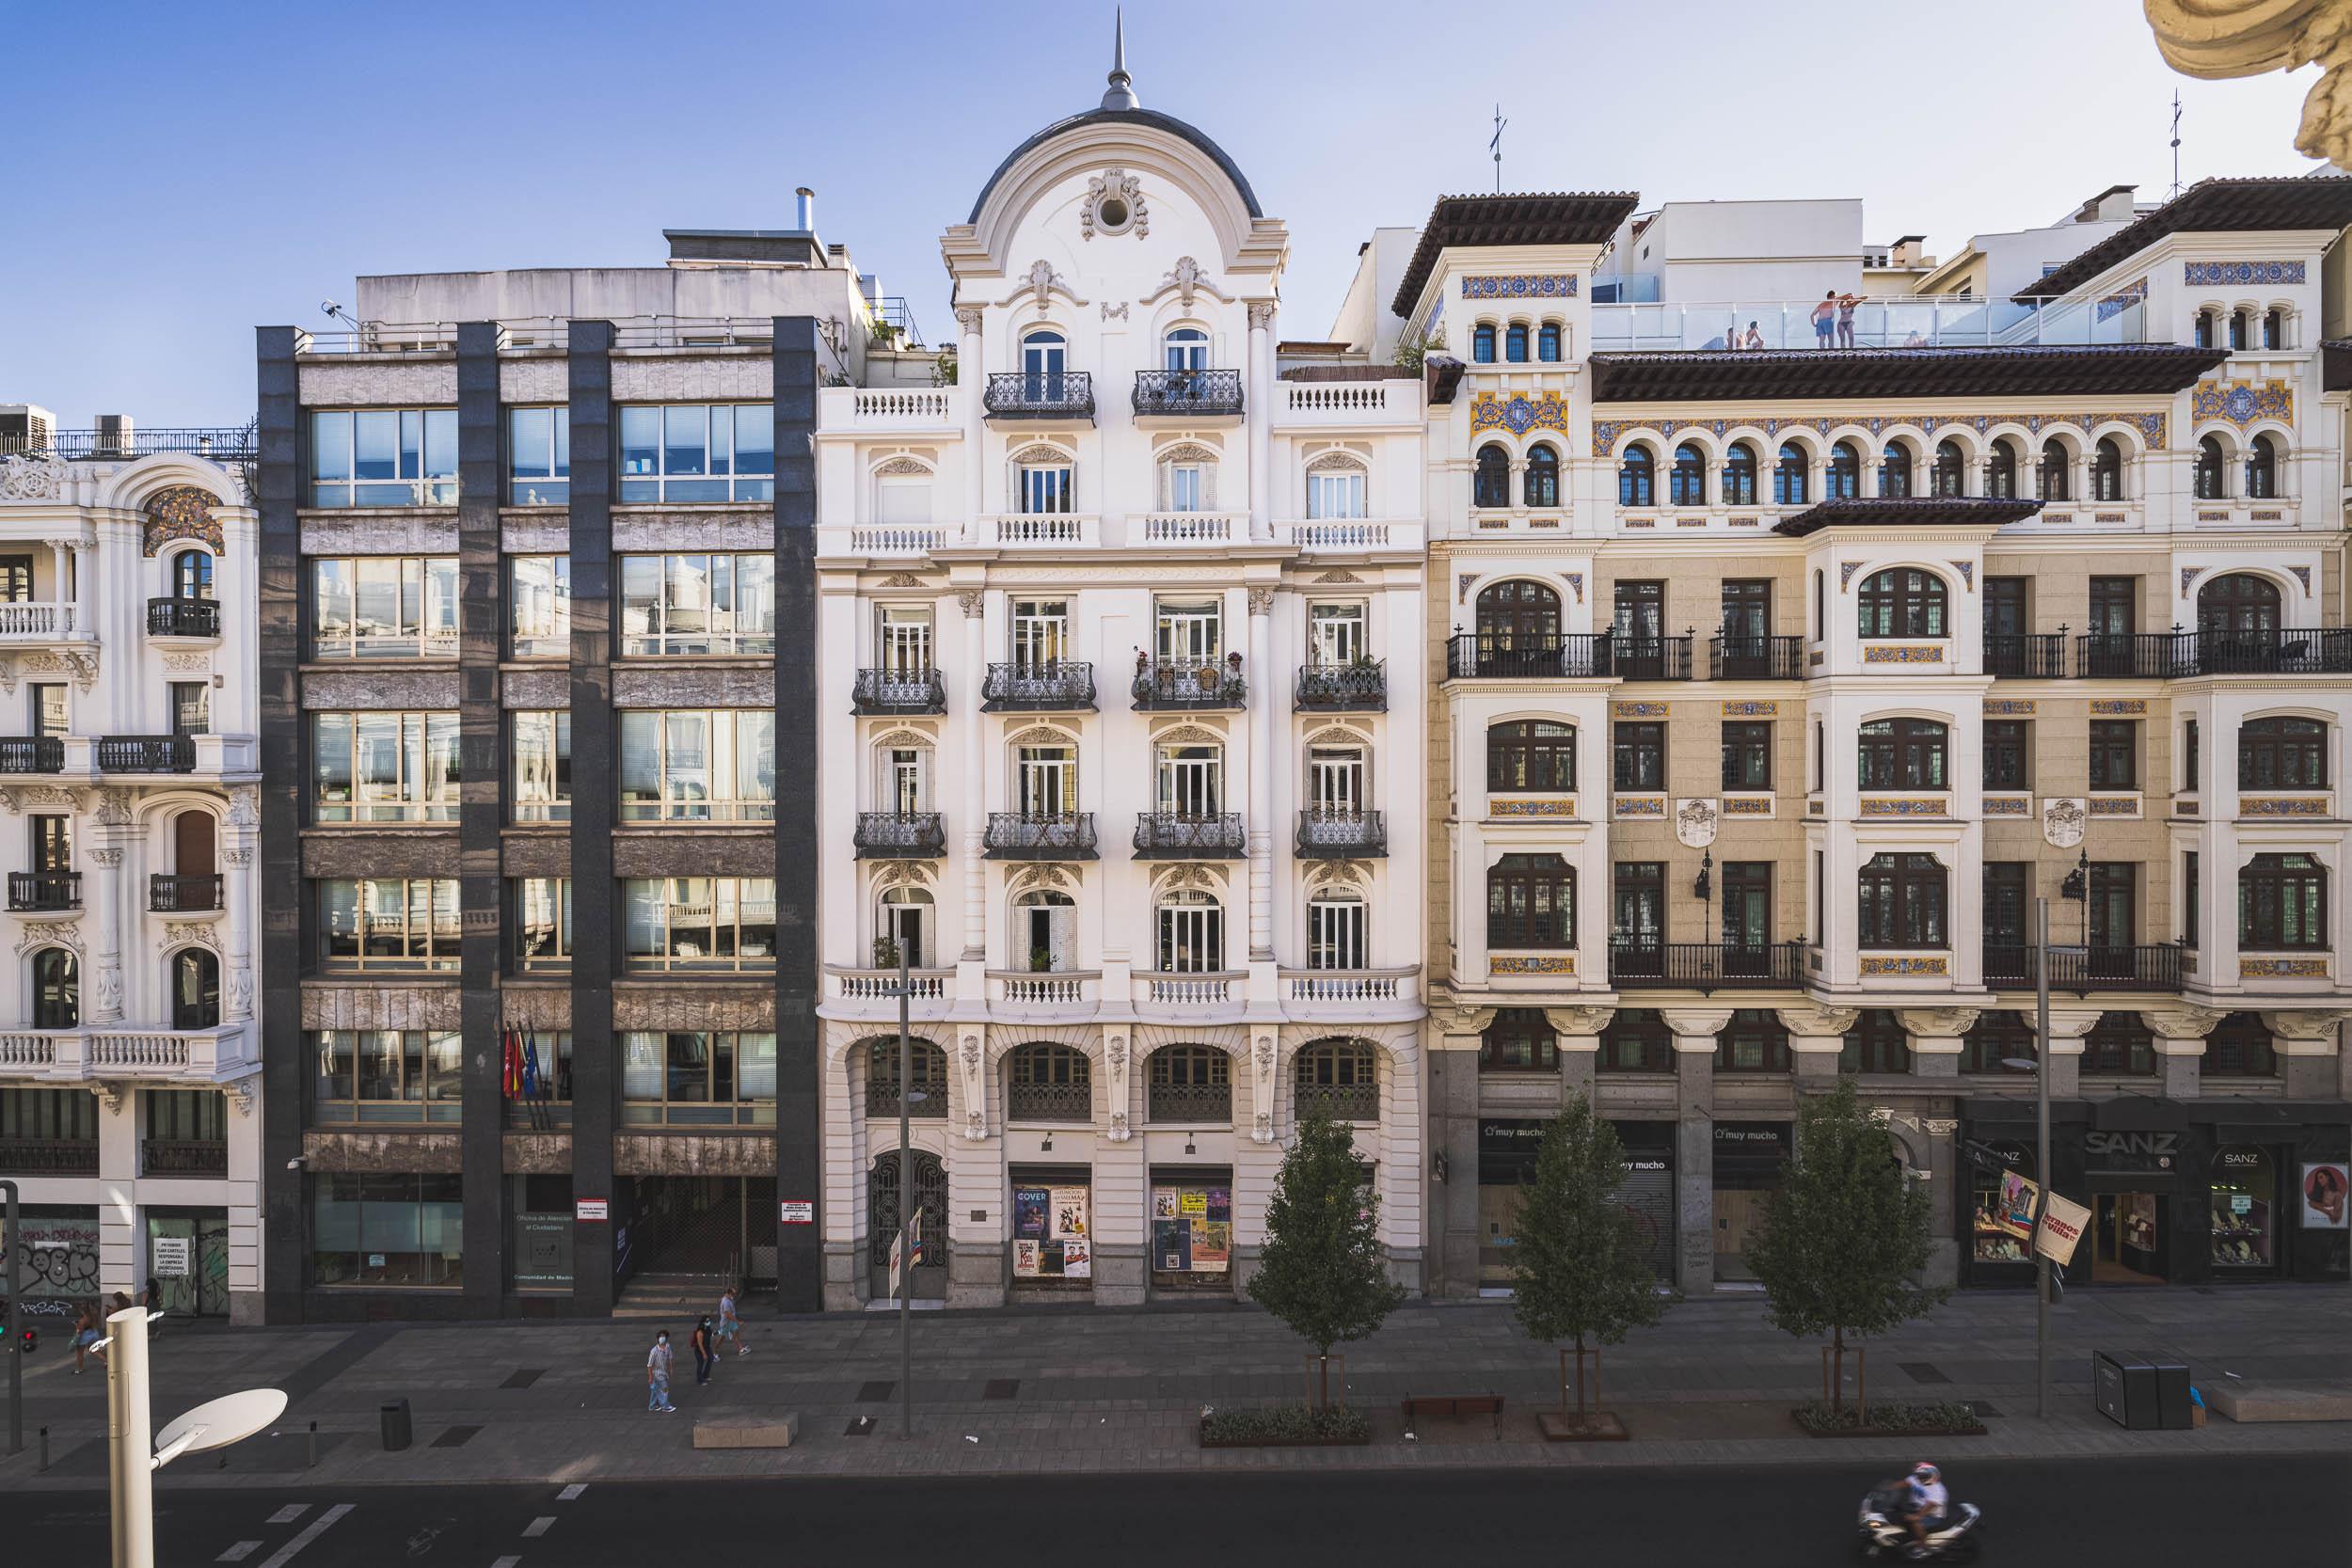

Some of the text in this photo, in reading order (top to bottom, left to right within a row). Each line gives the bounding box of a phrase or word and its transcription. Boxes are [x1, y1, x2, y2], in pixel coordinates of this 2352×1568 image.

[1496, 1128, 1547, 1139] muy mucho
[1725, 1131, 1777, 1141] muy mucho
[2085, 1132, 2178, 1154] SANZ
[2225, 1154, 2258, 1164] SANZ
[1636, 1161, 1665, 1169] mucho
[1017, 1193, 1047, 1201] COVER
